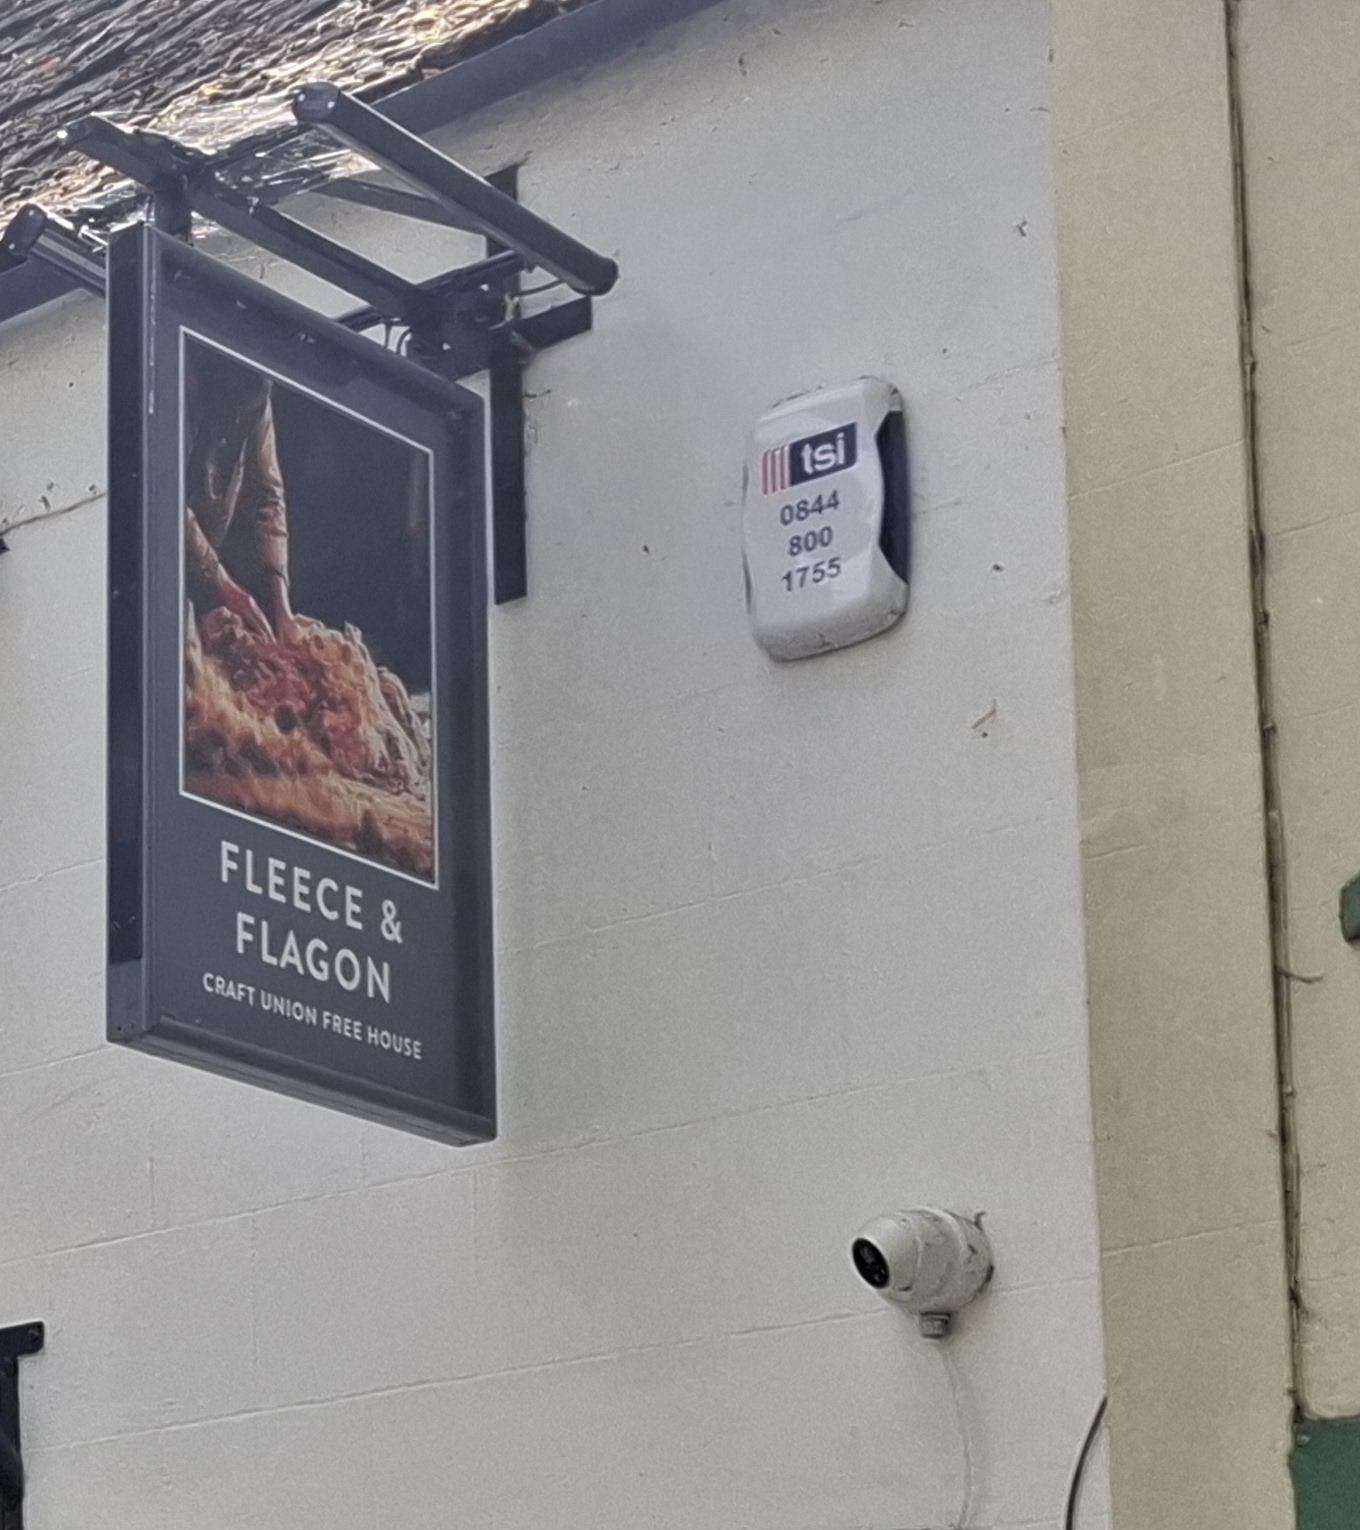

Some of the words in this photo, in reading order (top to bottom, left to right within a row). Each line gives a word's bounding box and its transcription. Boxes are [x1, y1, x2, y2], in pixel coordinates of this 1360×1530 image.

[800, 432, 846, 475] tsi
[780, 489, 840, 526] 0844
[788, 526, 834, 557] 800
[781, 556, 842, 592] 1755
[220, 839, 364, 931] FLEECE
[380, 899, 404, 944] &
[236, 911, 391, 1004] FLAGON
[202, 971, 257, 1007] CRAFT
[260, 991, 318, 1026] UNION
[322, 1011, 363, 1041] FREE
[367, 1027, 423, 1060] HOUSE
